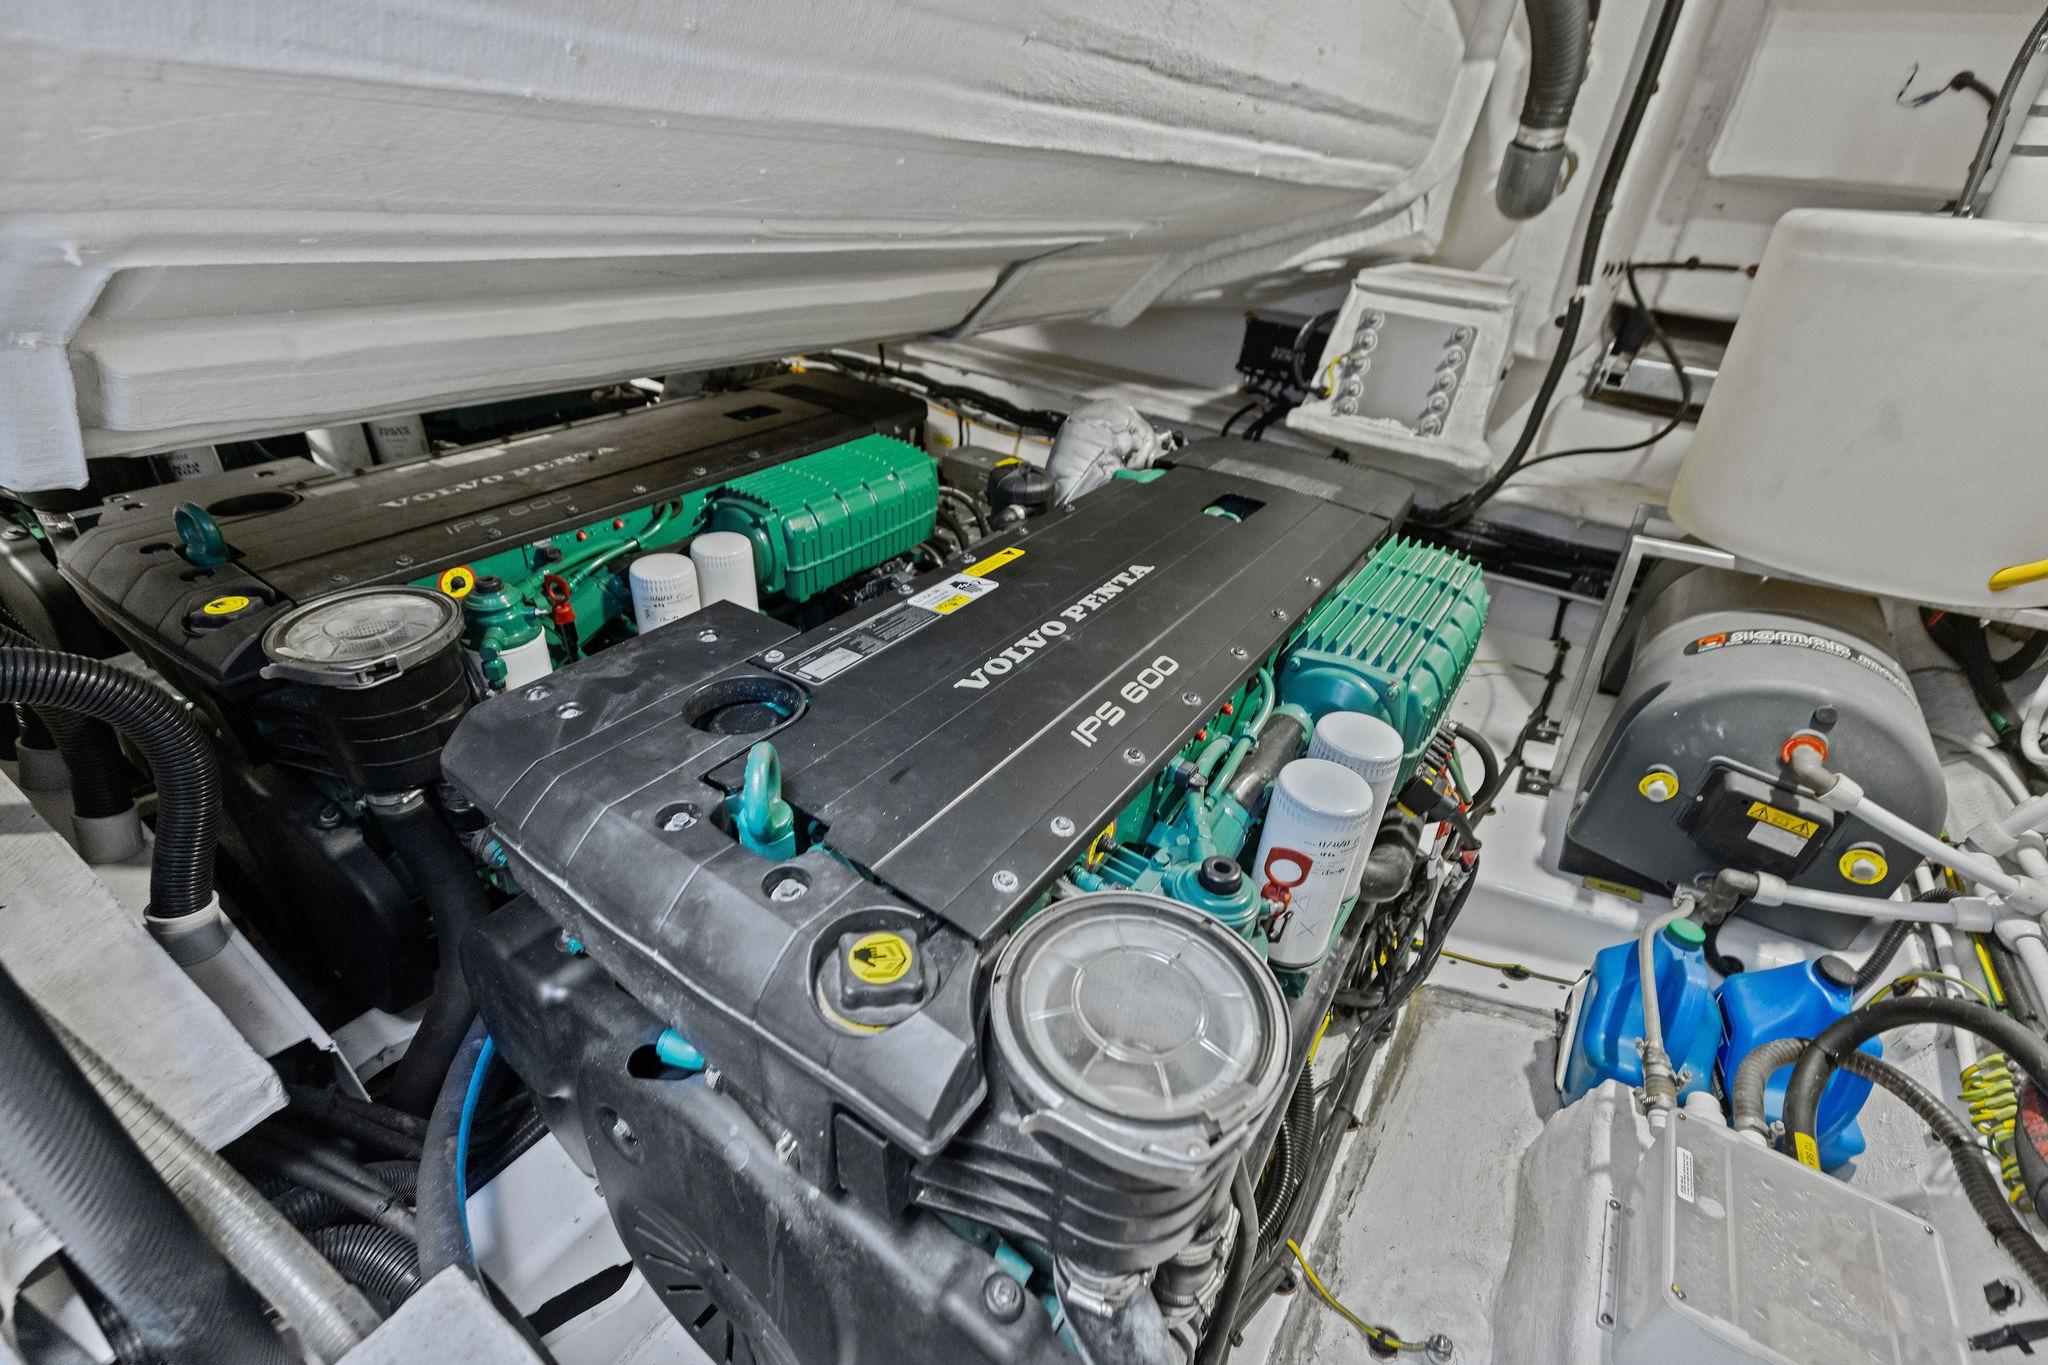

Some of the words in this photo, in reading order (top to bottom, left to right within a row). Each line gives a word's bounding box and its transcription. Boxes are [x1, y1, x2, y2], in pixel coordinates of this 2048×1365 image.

[378, 473, 504, 508] VOLVO
[445, 514, 500, 535] IPS
[508, 494, 572, 517] 600
[953, 620, 1067, 690] VOLVO
[1060, 564, 1156, 623] PENTA
[1071, 701, 1126, 748] IPS
[1120, 655, 1179, 704] 600
